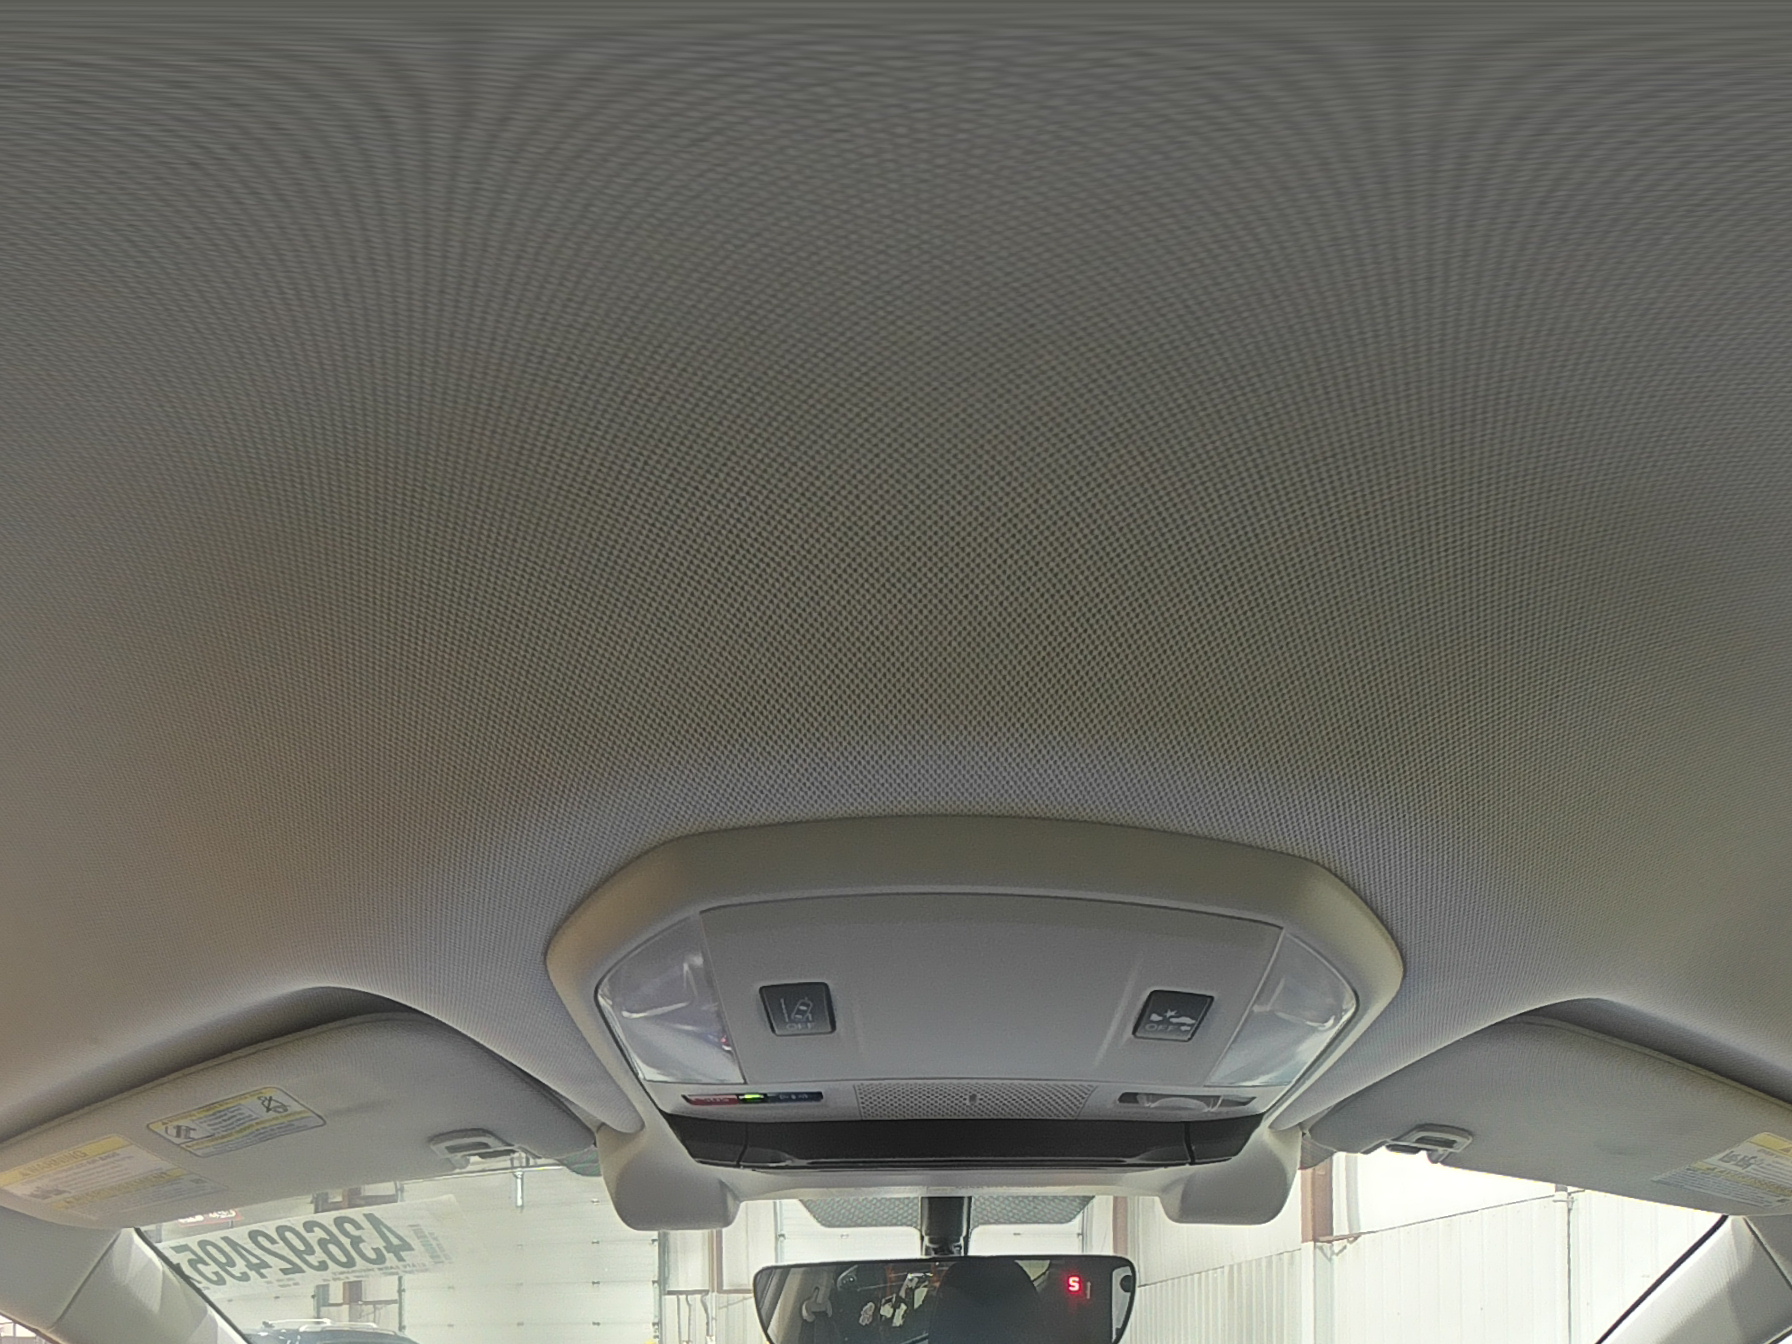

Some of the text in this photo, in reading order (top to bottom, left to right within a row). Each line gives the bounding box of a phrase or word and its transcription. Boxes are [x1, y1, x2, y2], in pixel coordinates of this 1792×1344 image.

[786, 1021, 815, 1031] OFF
[1144, 1023, 1178, 1033] OFF
[26, 1149, 88, 1178] WARNING
[1068, 1276, 1080, 1292] S
